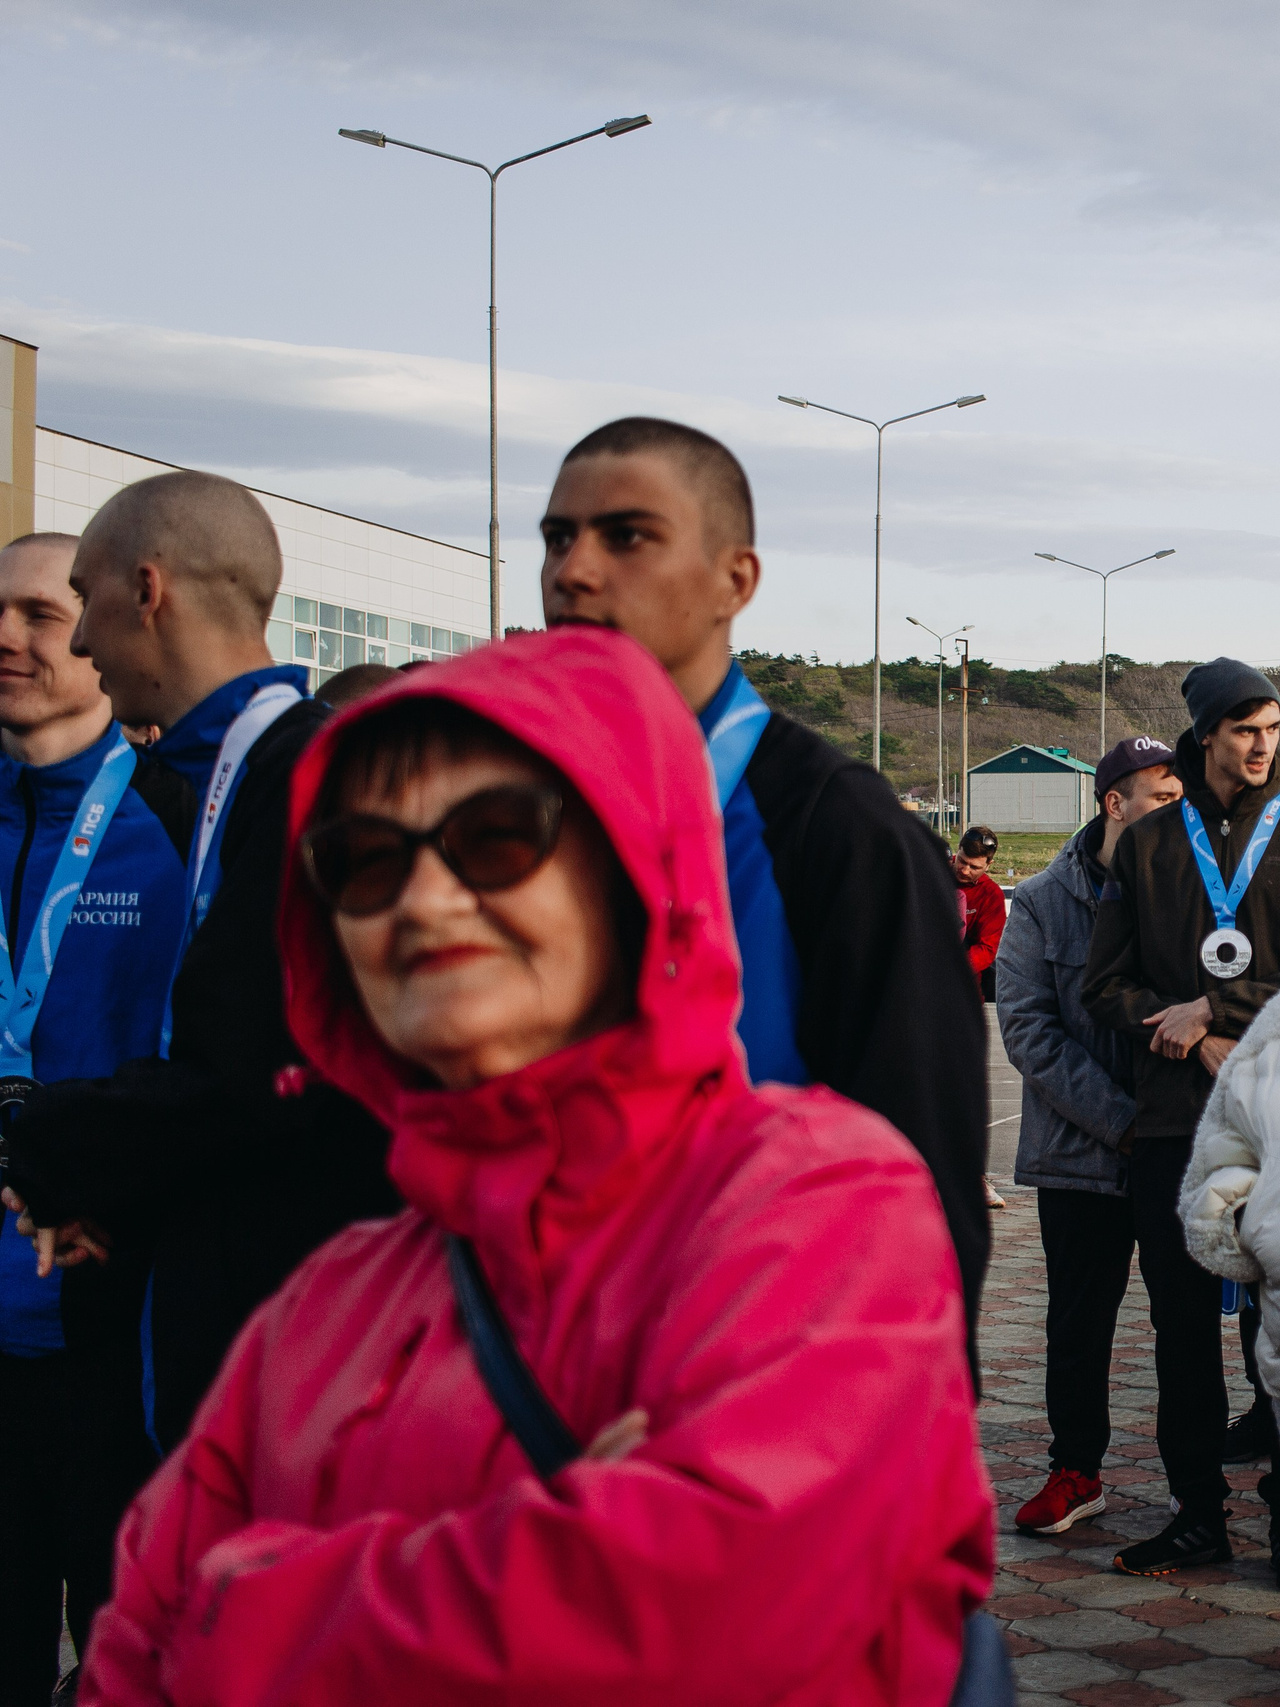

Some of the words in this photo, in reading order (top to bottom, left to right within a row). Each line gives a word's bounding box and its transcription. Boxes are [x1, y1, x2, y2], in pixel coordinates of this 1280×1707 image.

[1268, 800, 1280, 815] ПСБ
[81, 803, 105, 835] ПСБ
[75, 892, 139, 906] АРМИЯ
[67, 911, 141, 926] РОССИИ
